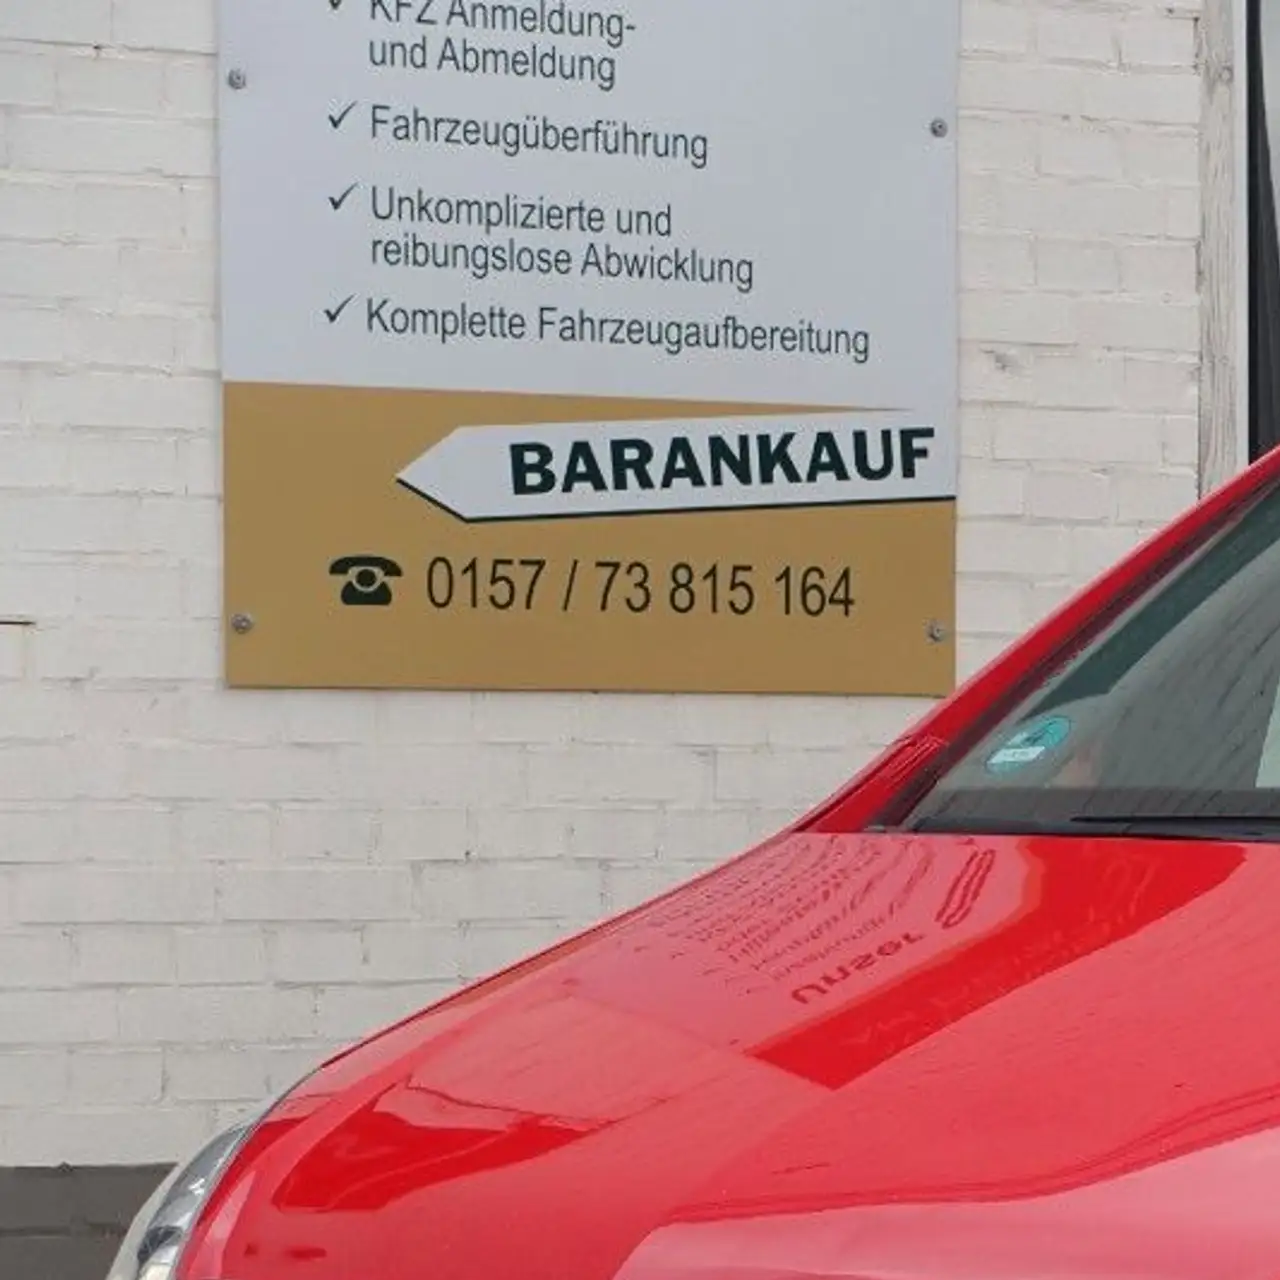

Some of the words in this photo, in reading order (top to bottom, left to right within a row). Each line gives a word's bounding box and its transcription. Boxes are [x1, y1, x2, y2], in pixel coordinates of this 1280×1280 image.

[369, 0, 438, 26] KFZ
[446, 0, 636, 49] Anmeldung-
[369, 36, 428, 70] und
[437, 37, 617, 92] Abmeldung
[371, 105, 709, 168] Fahrzeugüberführung
[371, 186, 606, 236] Unkomplizierte
[616, 204, 673, 238] und
[371, 235, 573, 279] reibungslose
[580, 243, 754, 294] Abwicklung
[366, 298, 526, 342] Komplette
[537, 307, 871, 364] Fahrzeugaufbereitung
[509, 427, 936, 495] BARANKAUF
[426, 556, 547, 611] 0157
[562, 559, 578, 611] /
[595, 560, 651, 612] 73
[669, 563, 755, 615] 815
[774, 565, 856, 617] 164
